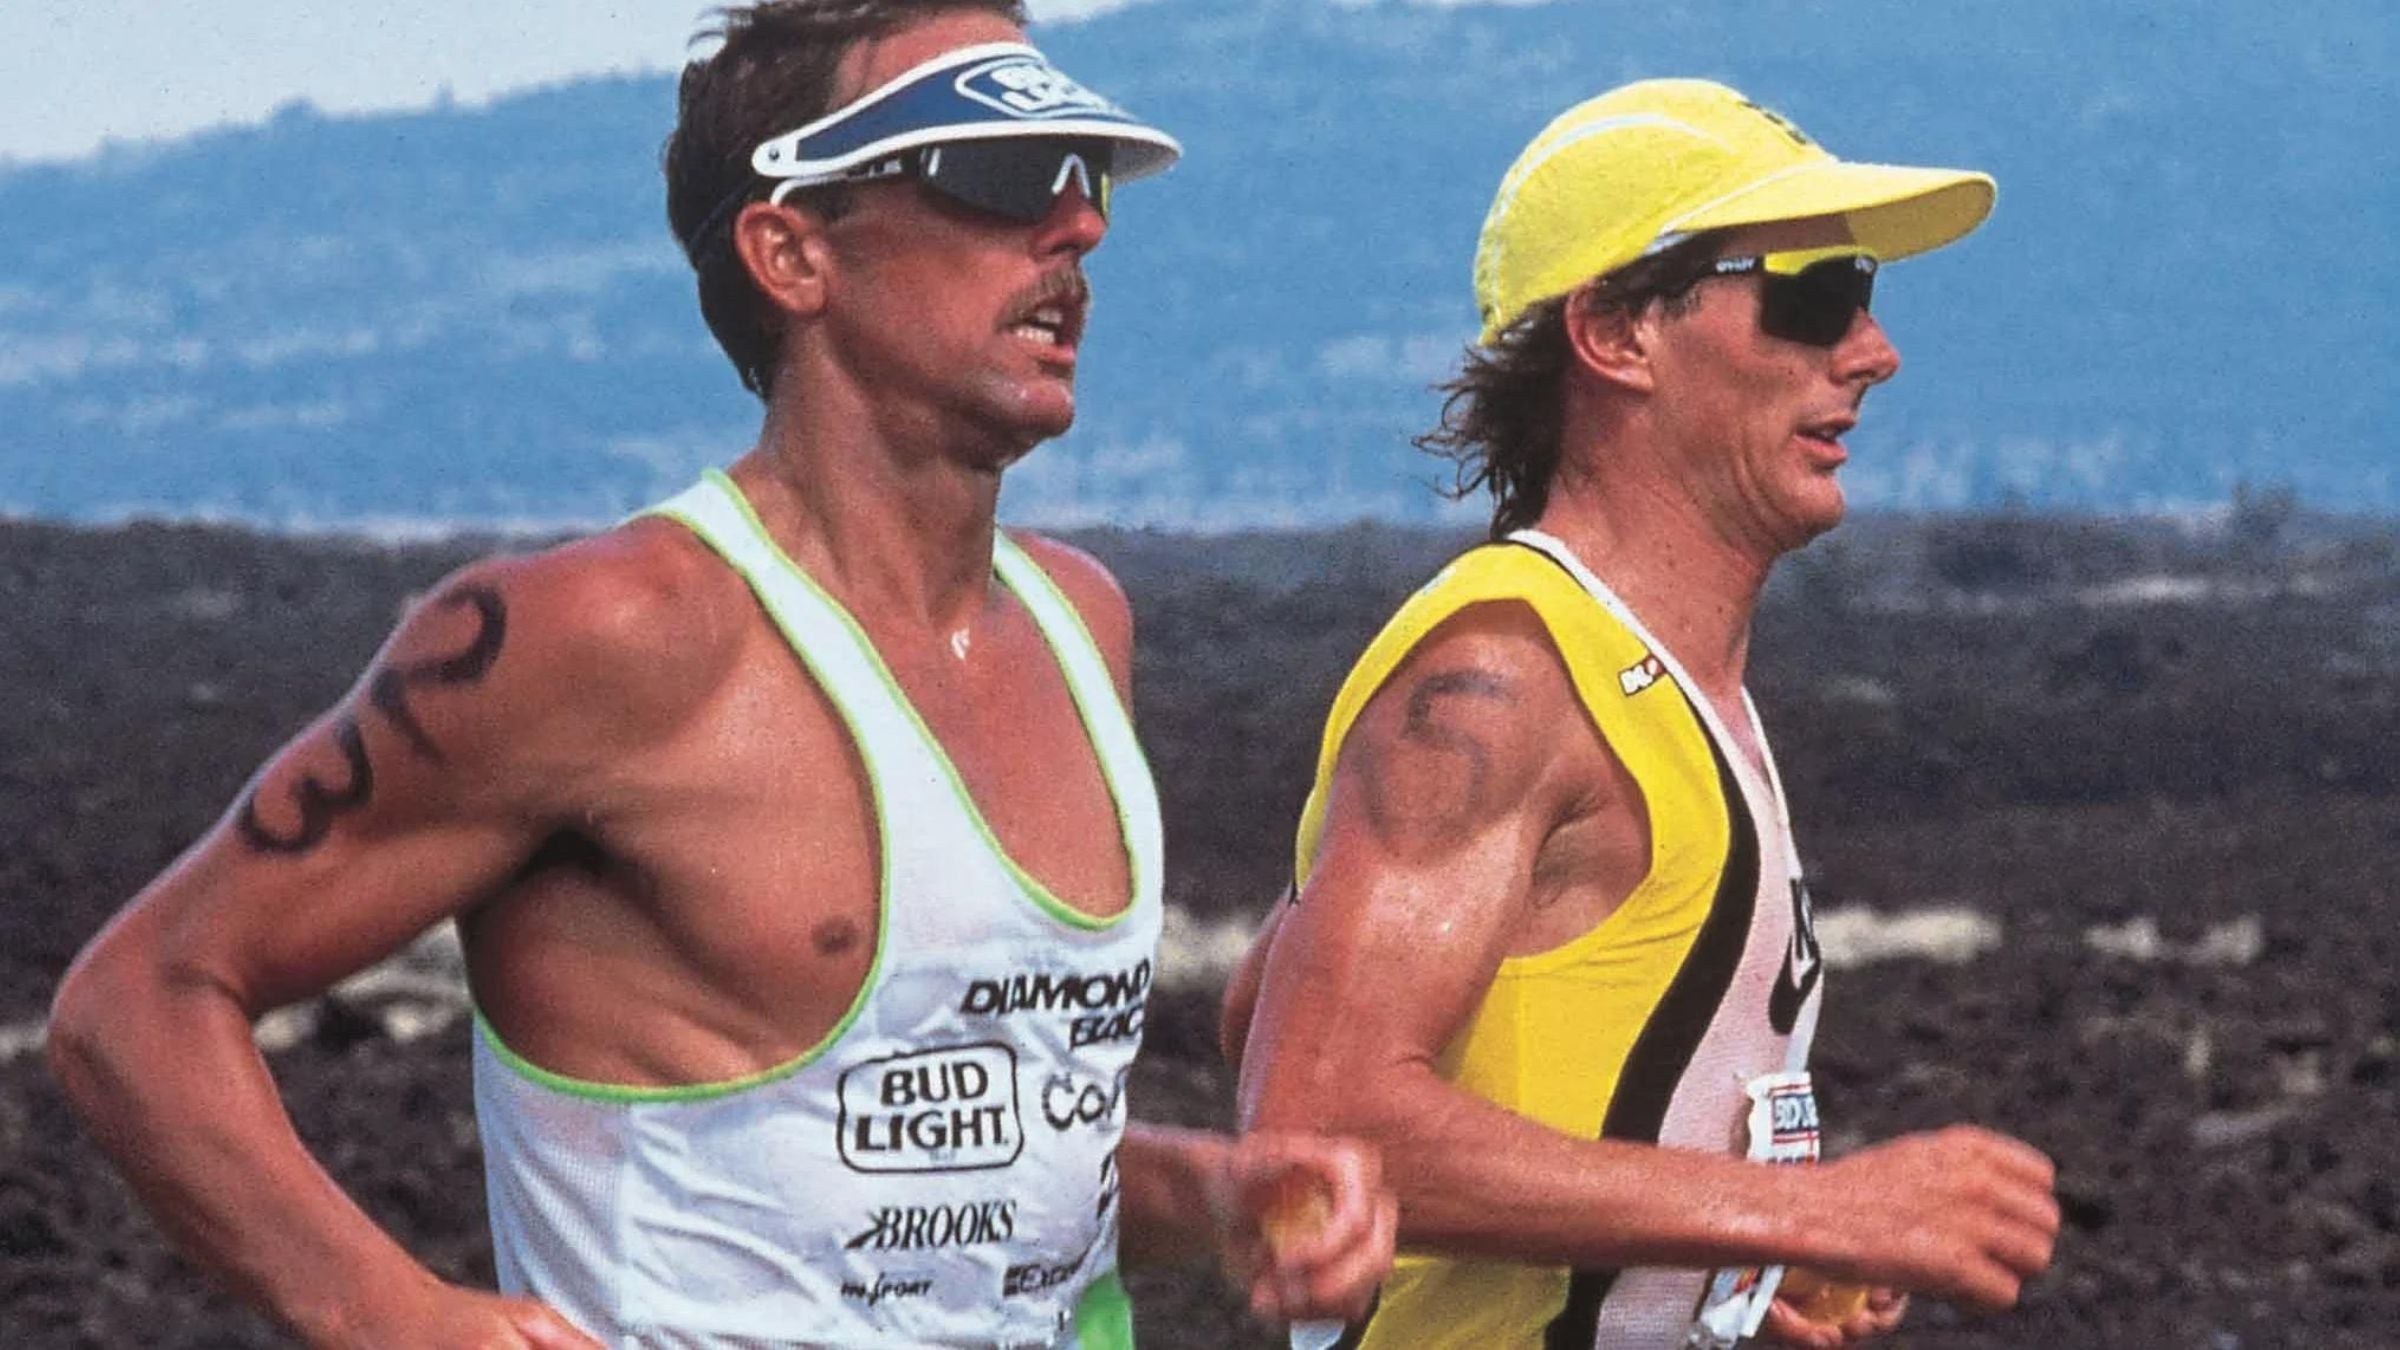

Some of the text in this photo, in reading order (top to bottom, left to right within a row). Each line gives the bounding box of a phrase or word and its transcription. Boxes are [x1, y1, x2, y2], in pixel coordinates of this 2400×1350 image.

[880, 1060, 989, 1107] BUD
[853, 1104, 1005, 1152] LIGHT
[876, 1200, 1017, 1251] BROOKS
